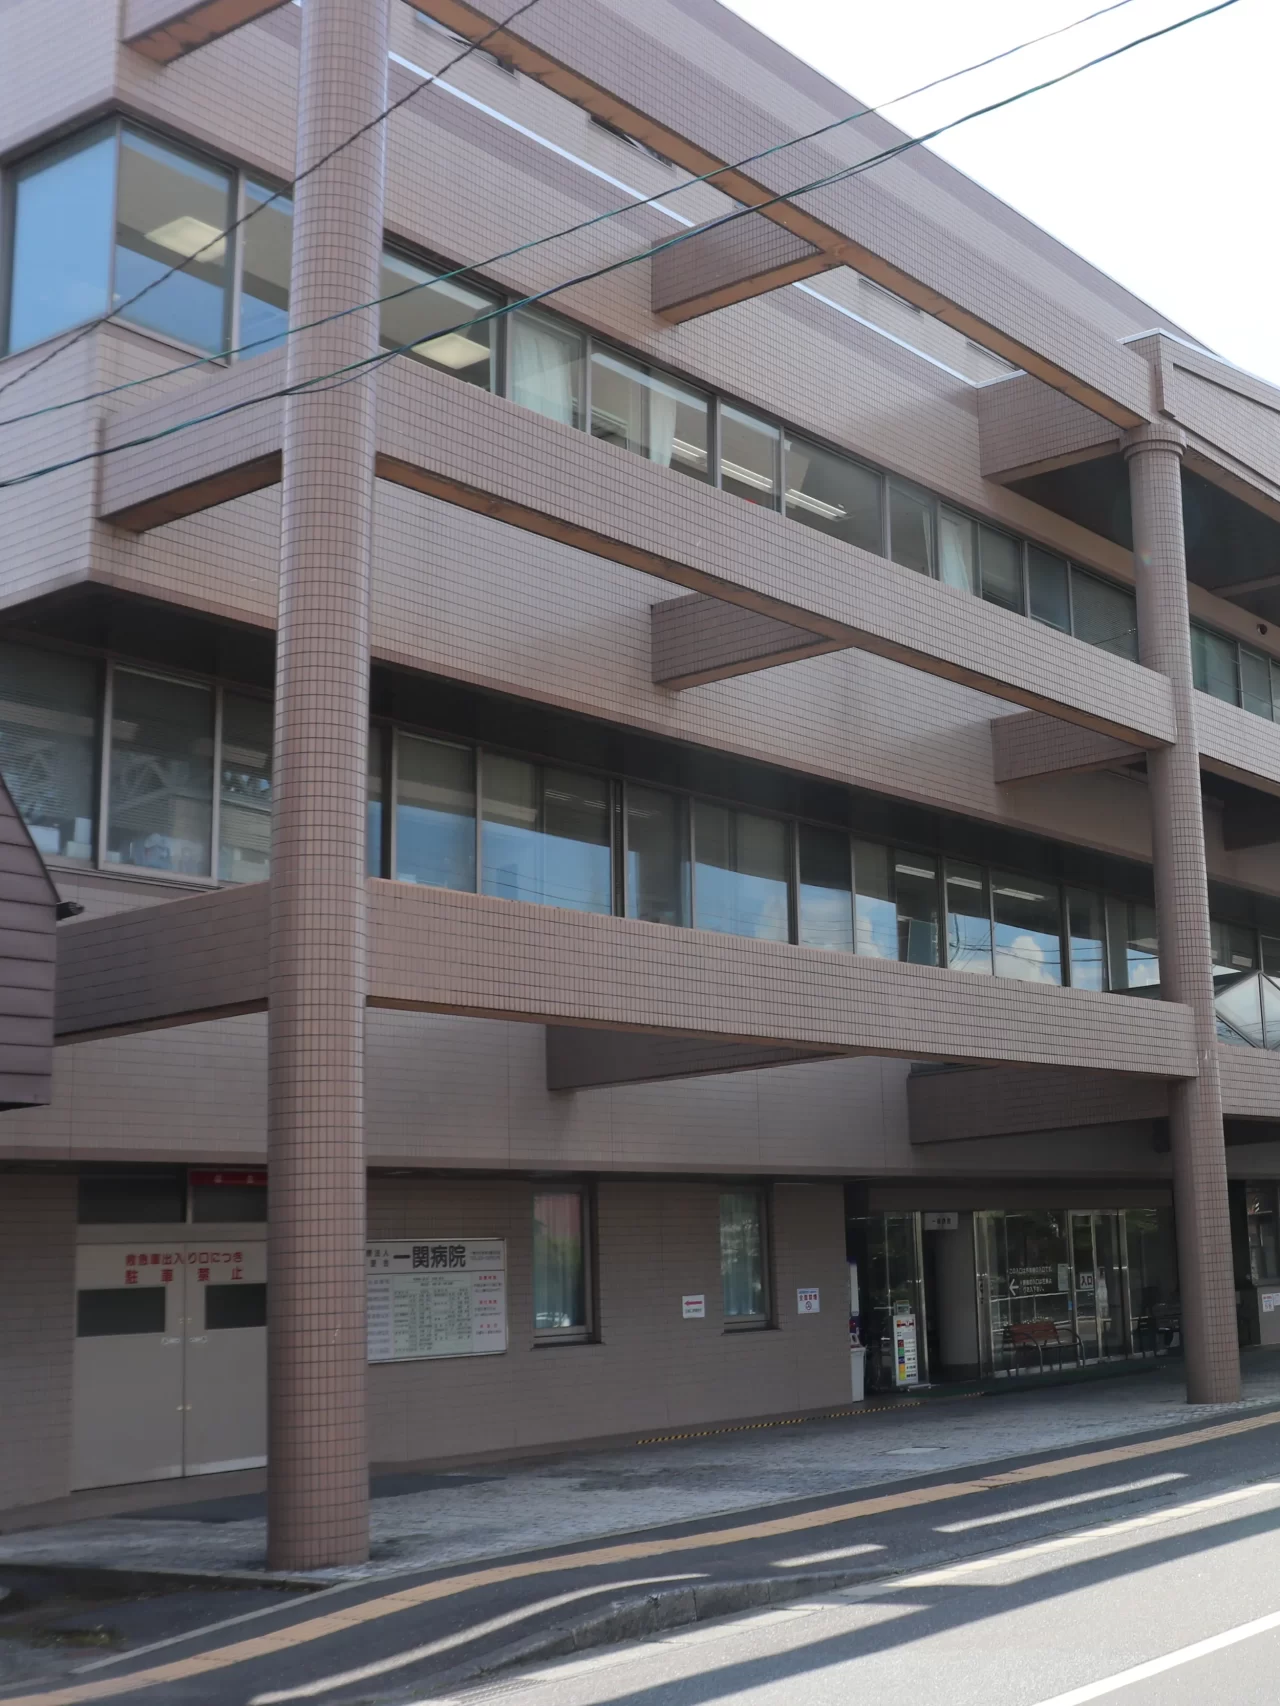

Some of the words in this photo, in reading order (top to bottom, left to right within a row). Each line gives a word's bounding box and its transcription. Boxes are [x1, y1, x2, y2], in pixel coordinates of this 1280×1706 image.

[393, 1244, 467, 1269] 一関病院
[125, 1267, 243, 1285] 駐車禁止
[1082, 1274, 1093, 1287] 入口
